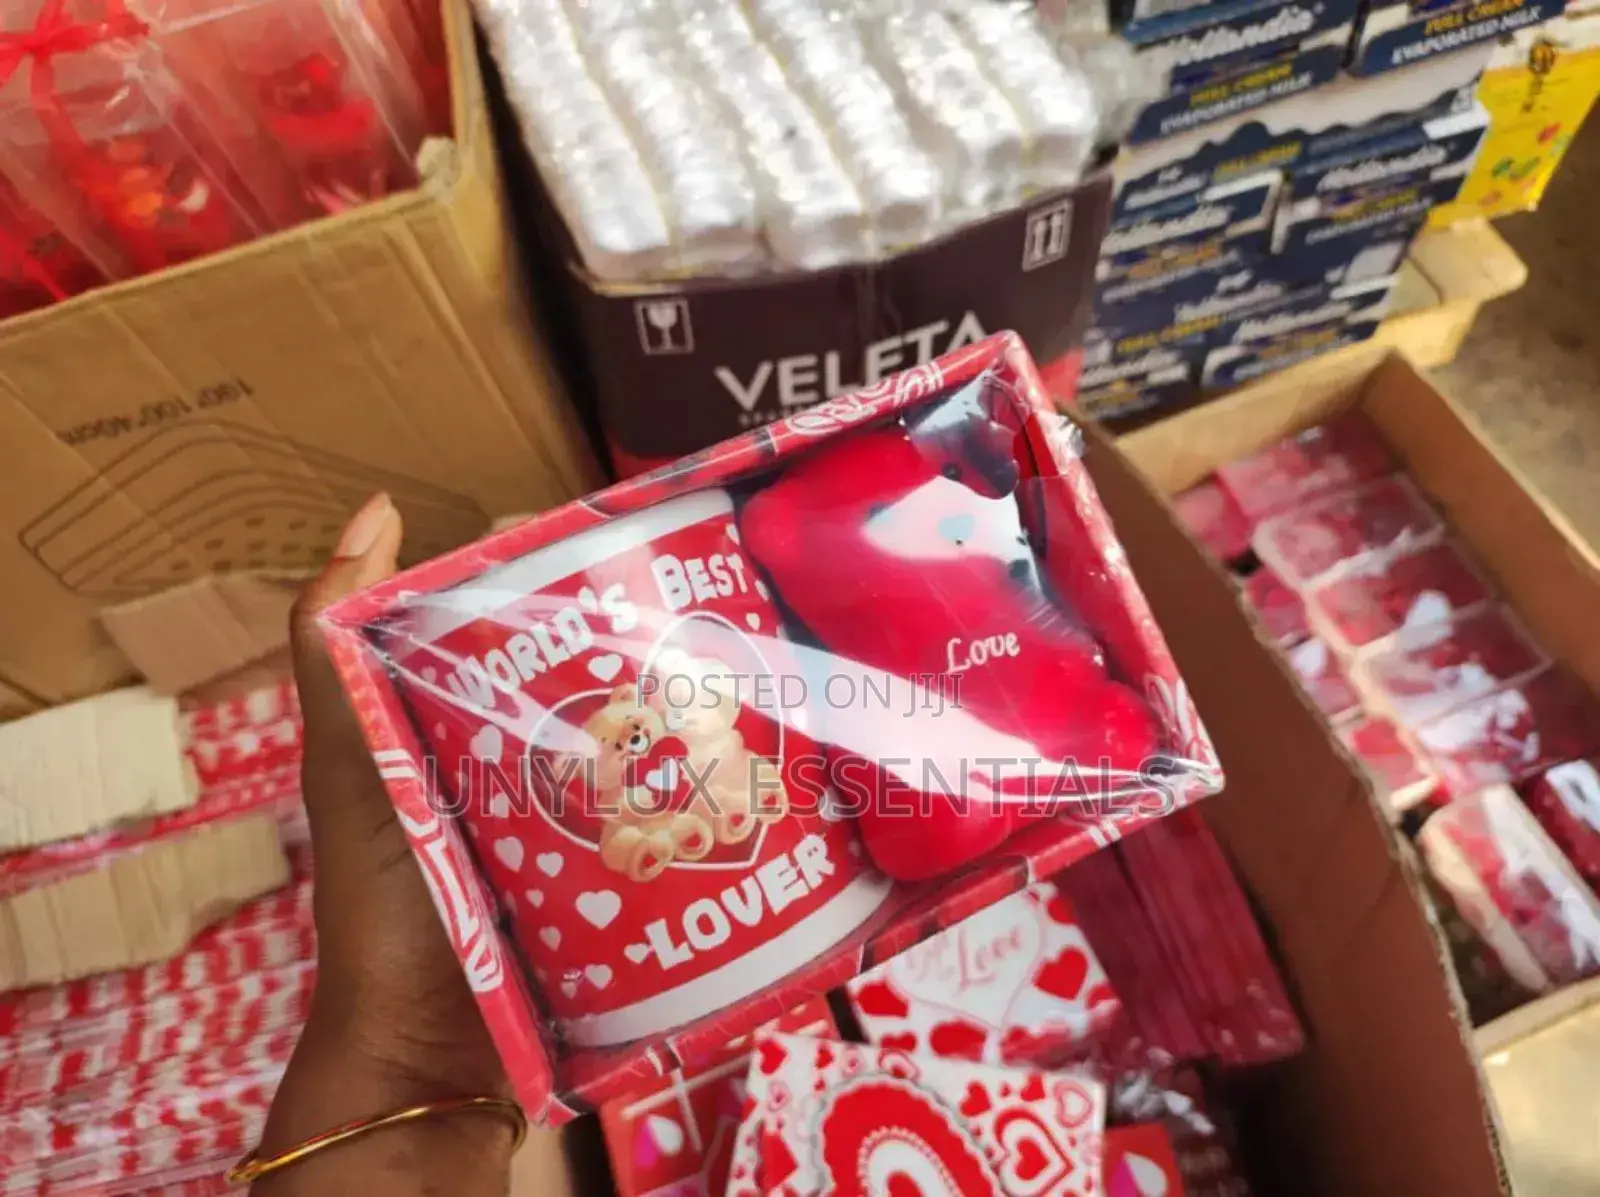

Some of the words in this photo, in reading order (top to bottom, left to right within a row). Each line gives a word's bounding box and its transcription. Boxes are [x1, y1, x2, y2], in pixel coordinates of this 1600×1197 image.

[651, 553, 748, 612] BEST
[946, 631, 1020, 674] Love
[645, 833, 835, 970] LOVER
